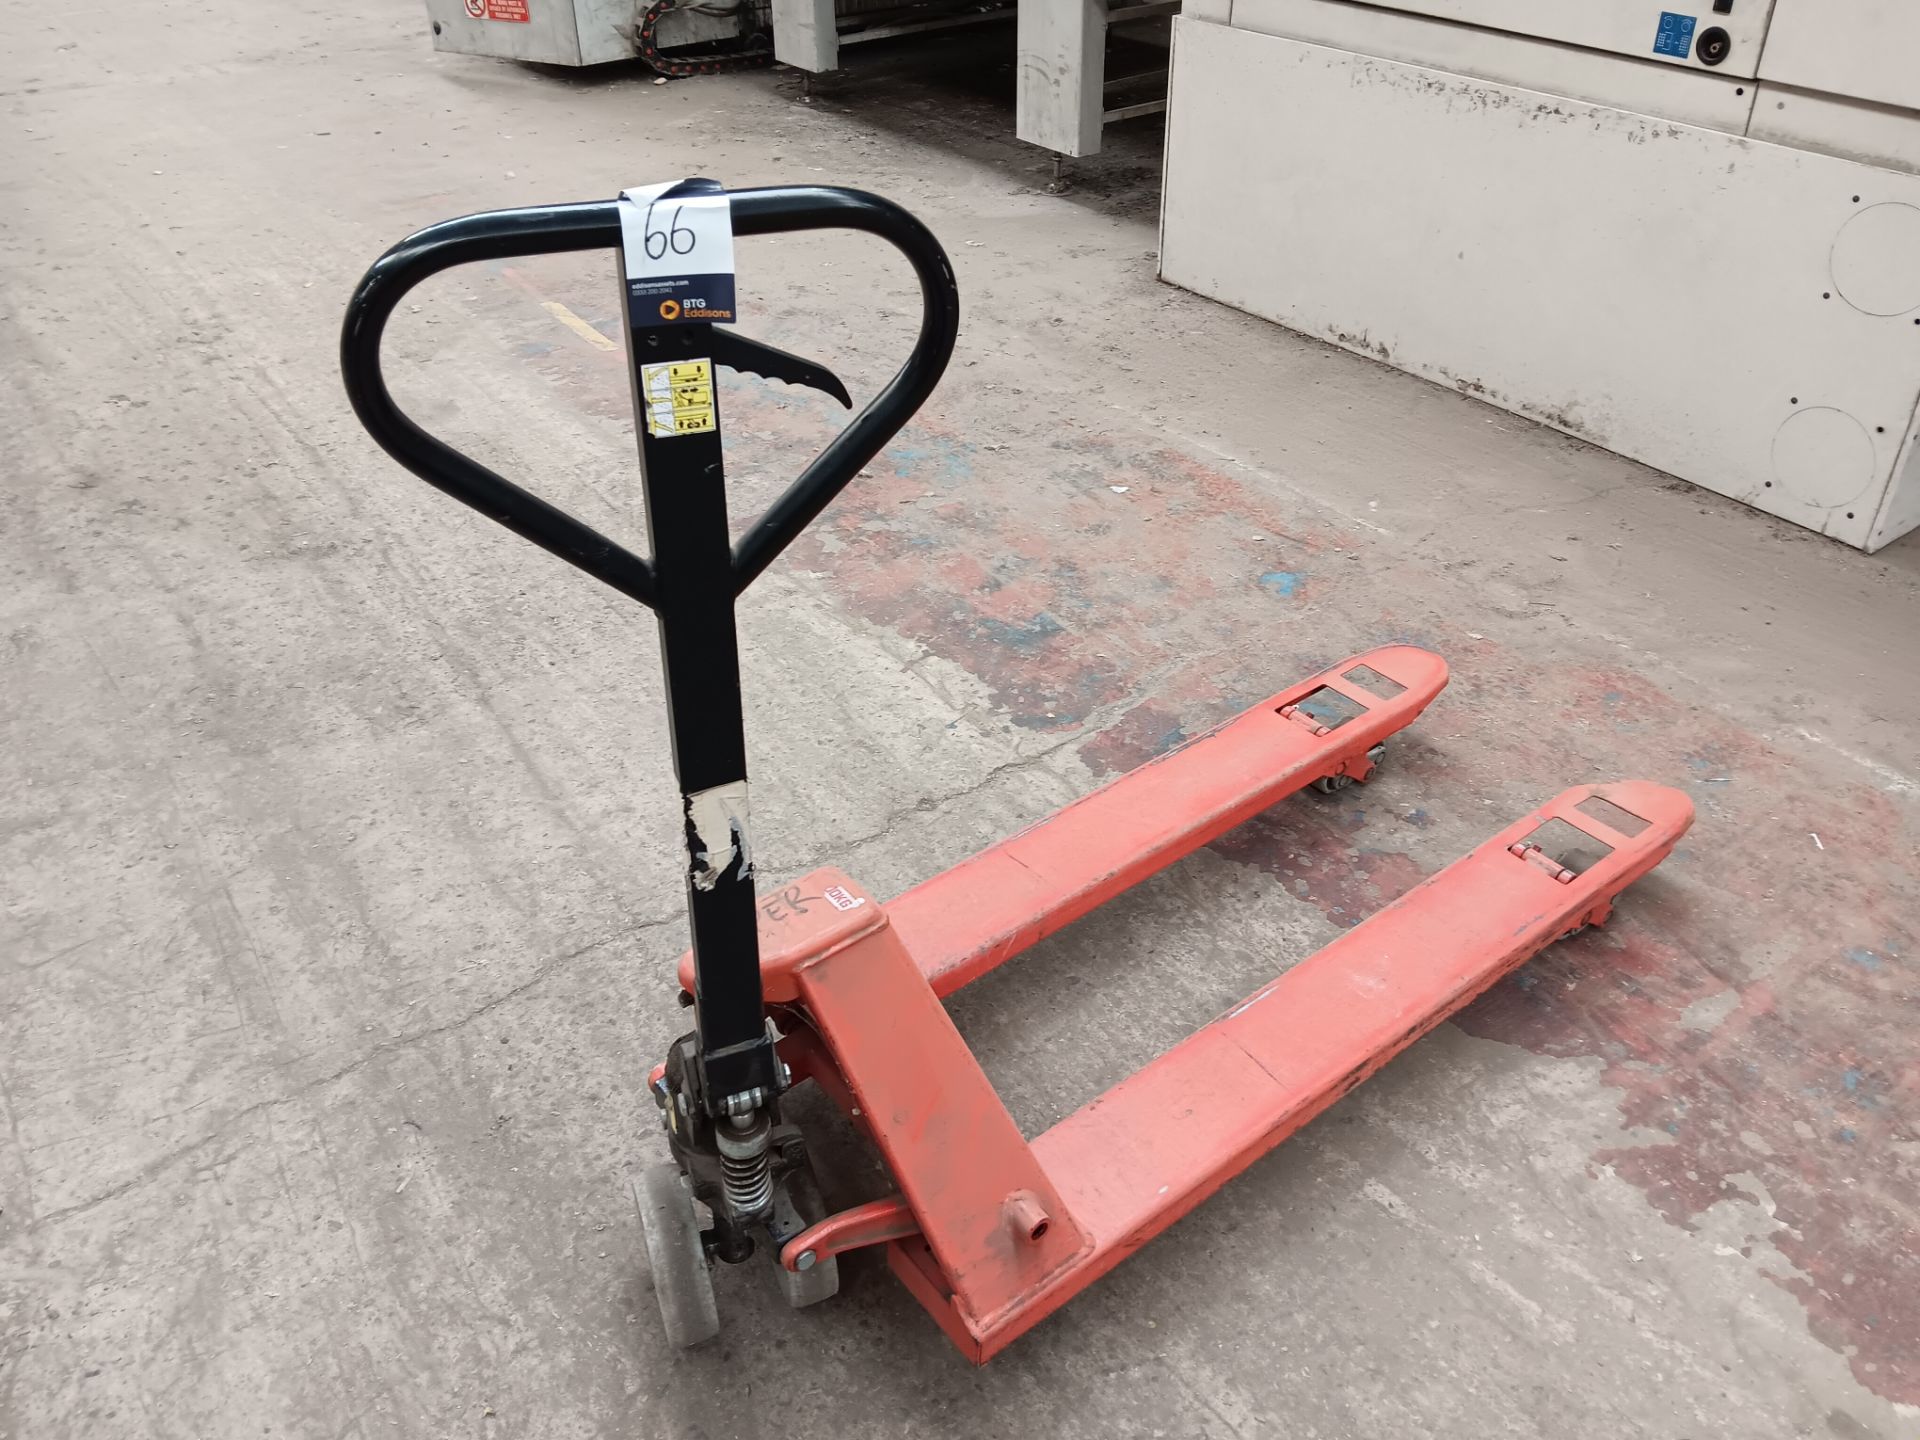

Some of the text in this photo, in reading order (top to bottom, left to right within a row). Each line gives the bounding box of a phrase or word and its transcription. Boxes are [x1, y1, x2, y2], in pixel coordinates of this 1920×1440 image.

[644, 203, 696, 260] 66
[683, 298, 706, 308] BTG
[684, 308, 731, 319] Eddisons
